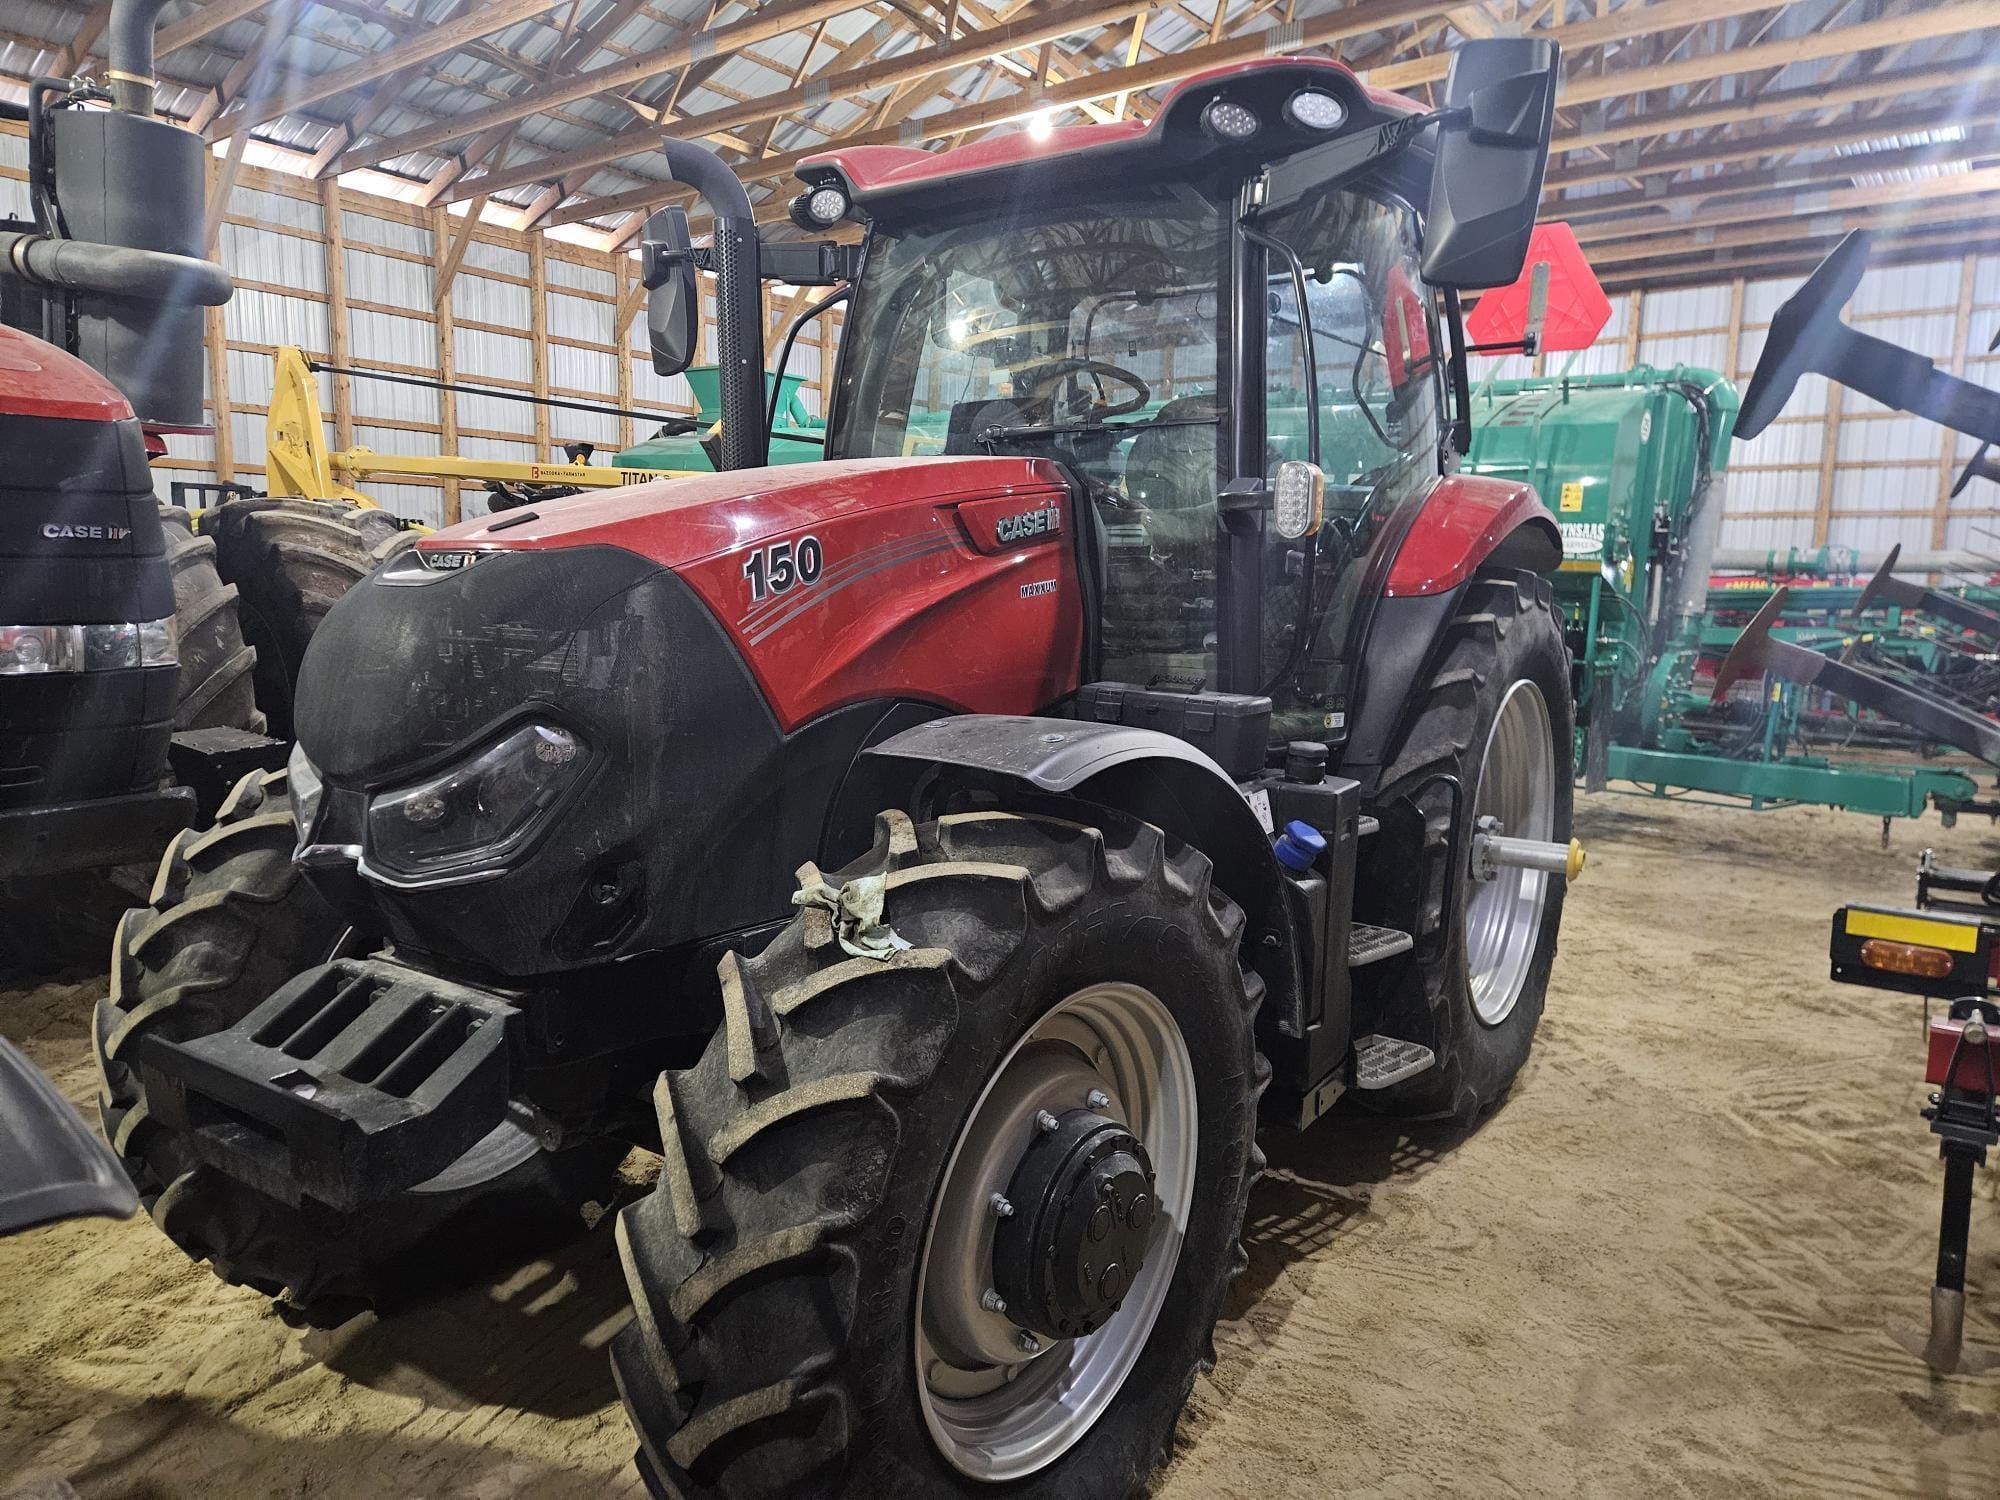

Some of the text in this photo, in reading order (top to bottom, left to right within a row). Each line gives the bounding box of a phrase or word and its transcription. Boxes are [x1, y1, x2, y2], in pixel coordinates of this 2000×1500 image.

[43, 524, 102, 539] CASE
[998, 510, 1046, 541] CASE
[429, 554, 462, 568] CASE
[742, 535, 824, 601] 150
[1020, 579, 1057, 599] MAXXUM
